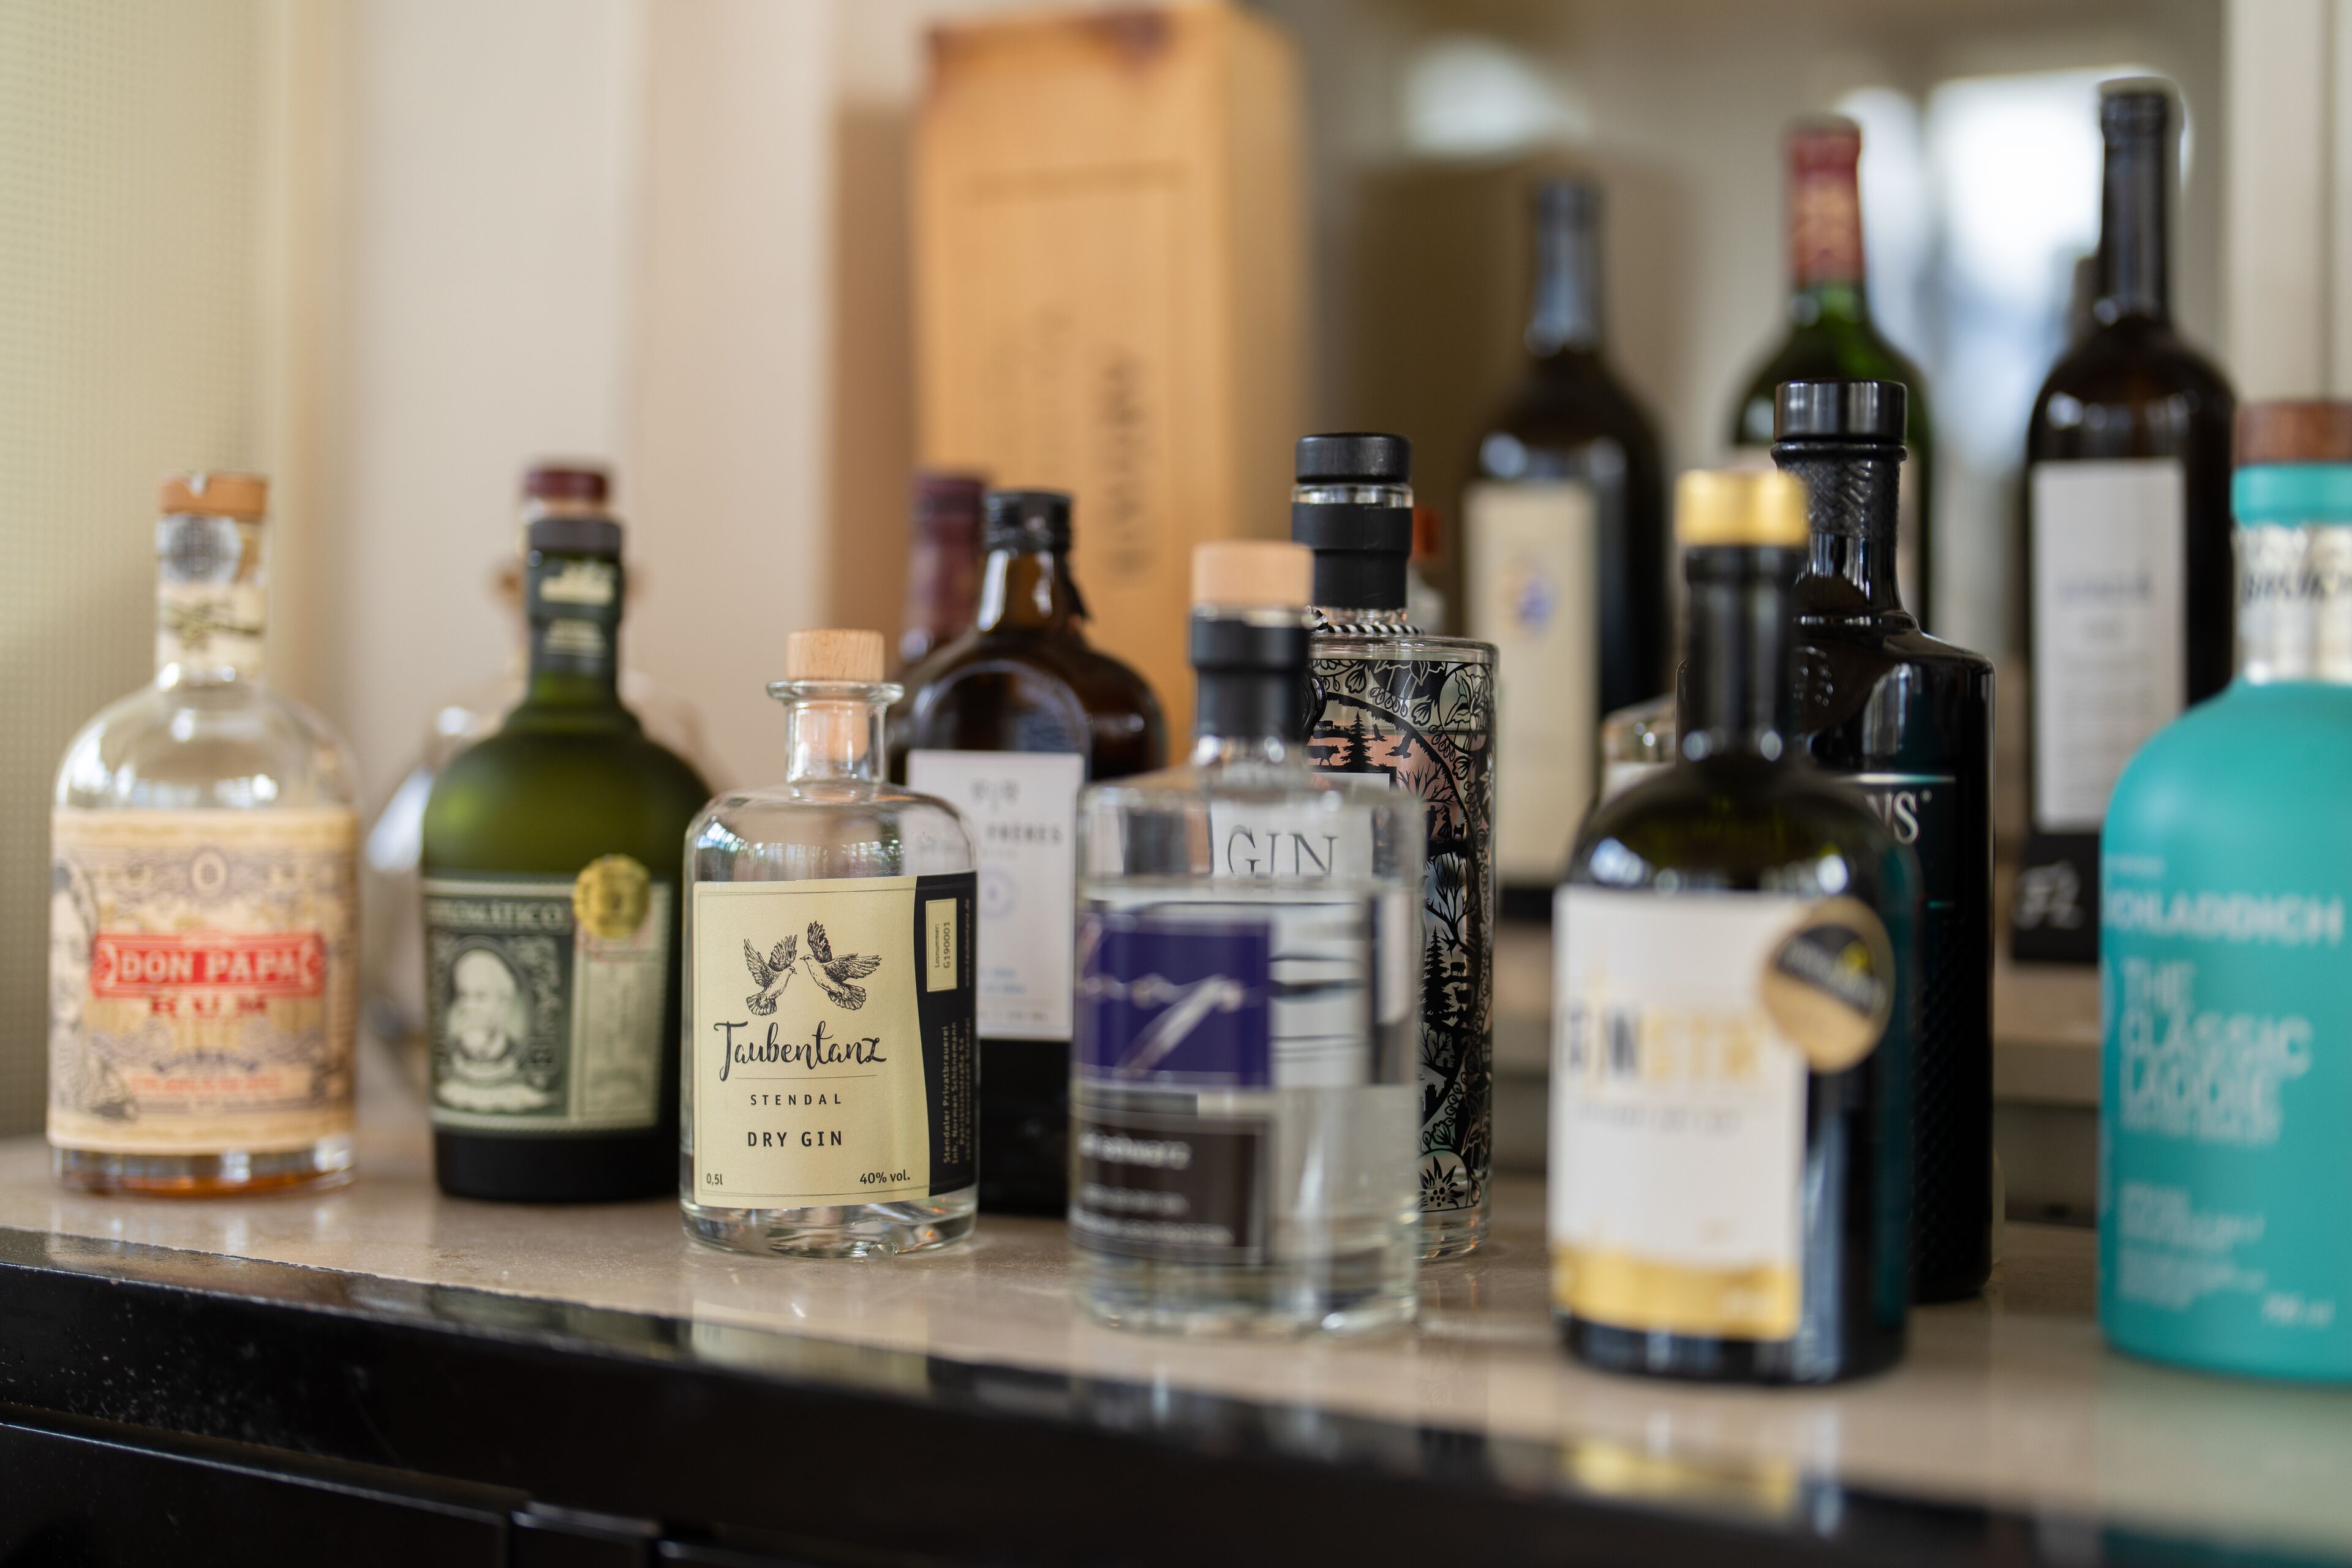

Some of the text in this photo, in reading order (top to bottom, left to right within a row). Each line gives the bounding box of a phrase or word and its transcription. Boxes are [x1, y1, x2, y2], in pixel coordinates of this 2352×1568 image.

[123, 950, 297, 982] DON PAPA
[152, 992, 268, 1019] RUM
[714, 1020, 887, 1082] Taubentanz
[750, 1093, 842, 1106] STENDAL
[747, 1130, 842, 1147] DRY GIN
[859, 1169, 910, 1185] 40% vol.
